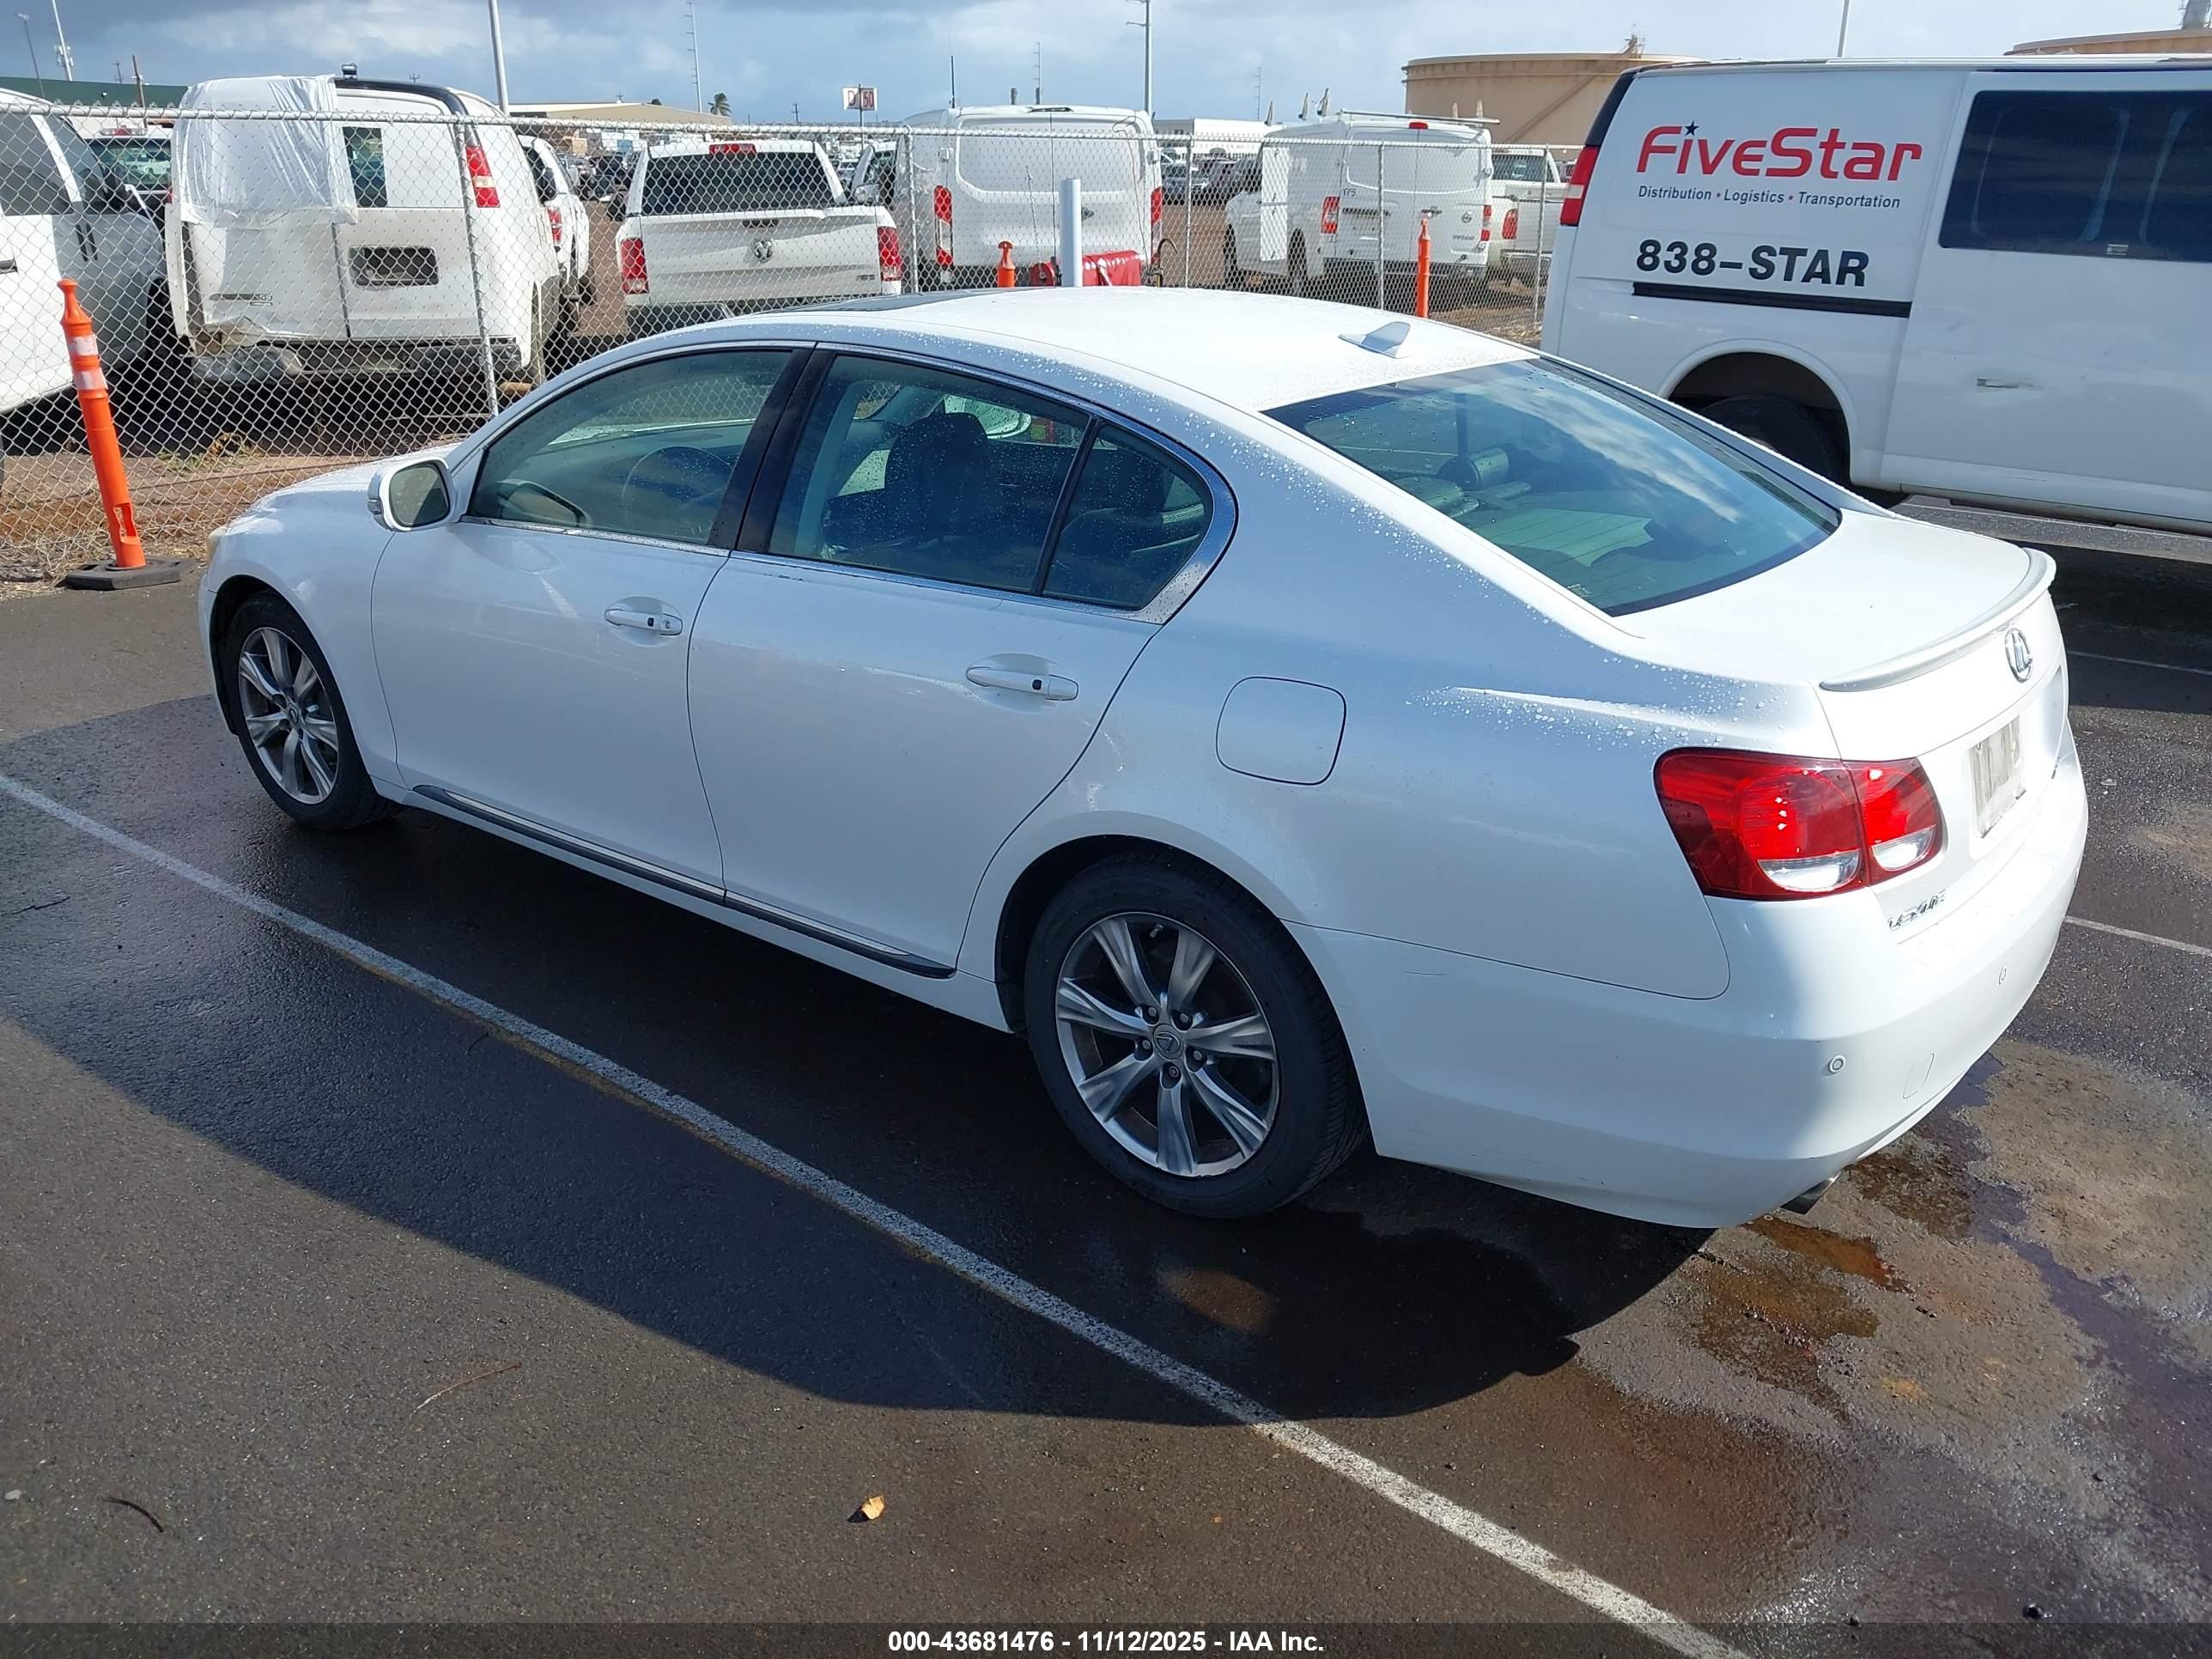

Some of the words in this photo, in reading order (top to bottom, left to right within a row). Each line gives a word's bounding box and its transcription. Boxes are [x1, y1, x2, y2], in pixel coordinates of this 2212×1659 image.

[1638, 185, 1712, 199] Distribution
[1723, 188, 1784, 205] Logistics
[1799, 191, 1900, 209] Transportation
[1637, 239, 1869, 287] 838-STAR
